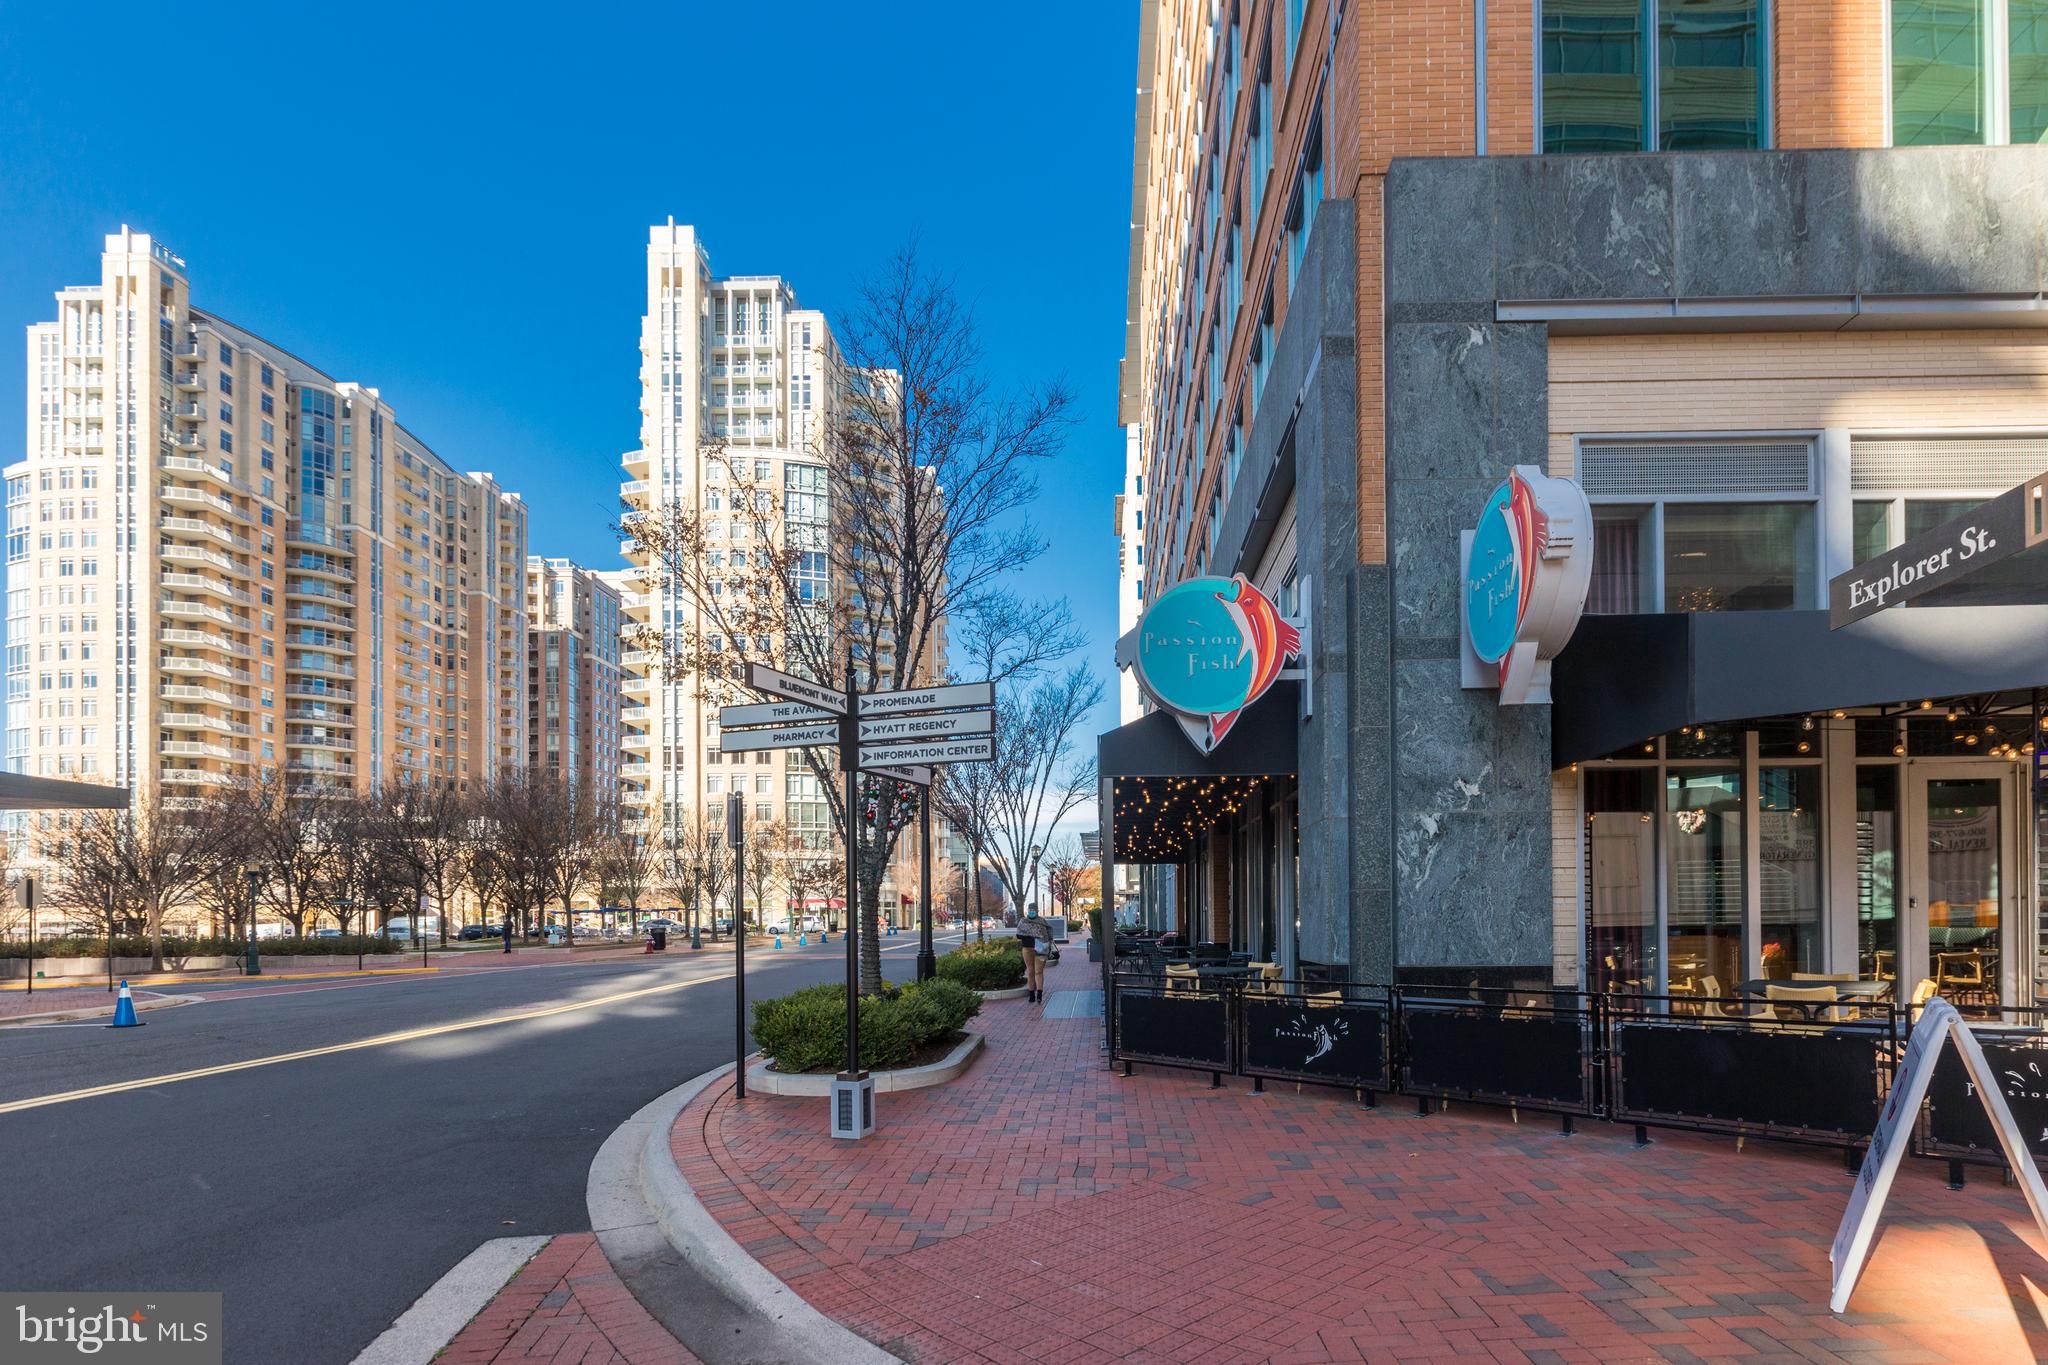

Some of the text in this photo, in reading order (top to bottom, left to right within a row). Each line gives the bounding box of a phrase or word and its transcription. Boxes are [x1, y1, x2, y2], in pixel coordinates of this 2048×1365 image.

[1468, 552, 1514, 605] Passion
[1848, 526, 1997, 610] Explorer St.
[1144, 631, 1238, 656] Passion
[1187, 652, 1236, 677] Fish
[779, 679, 838, 705] BLUEMONT WAY
[873, 694, 936, 708] PROMENADE
[772, 707, 790, 717] THE
[772, 729, 825, 743] PHARMACY
[873, 719, 957, 735] HYATT REGENCY
[873, 743, 989, 761] INFORMATION CENTER
